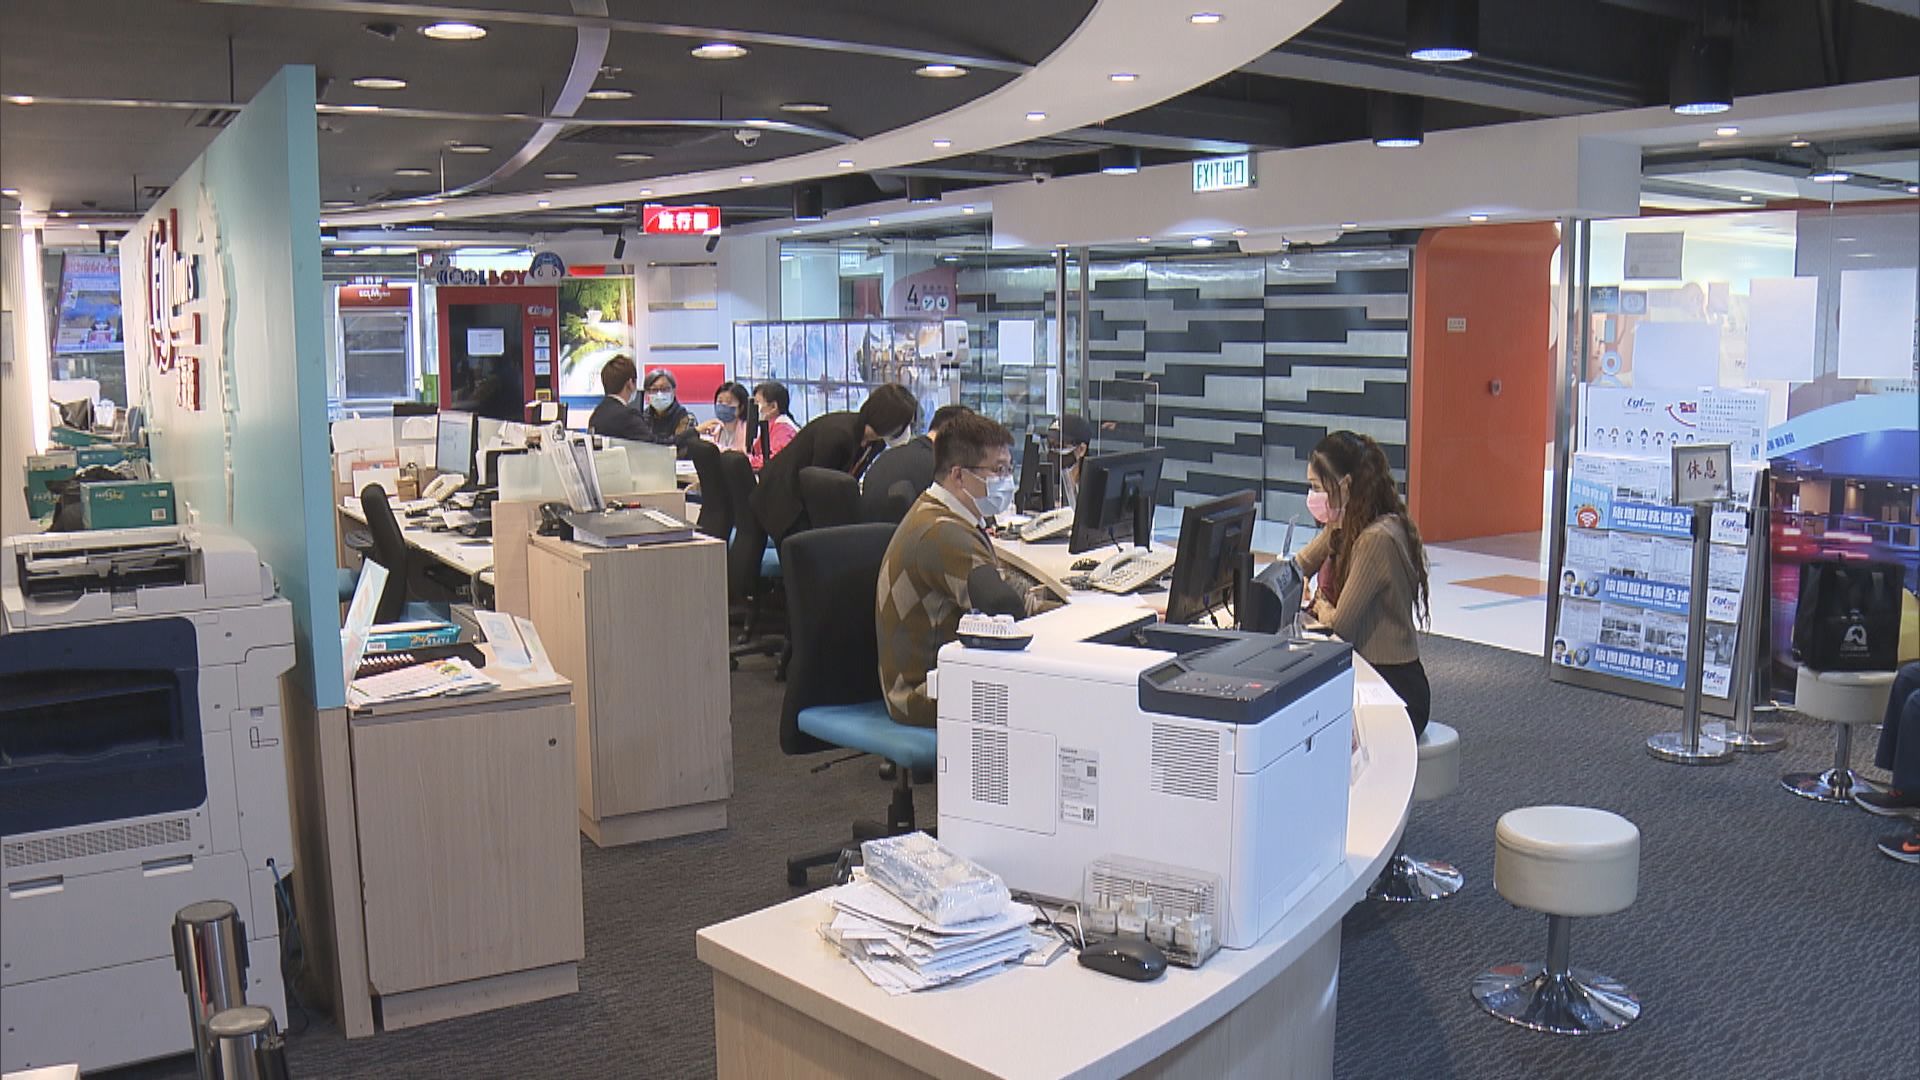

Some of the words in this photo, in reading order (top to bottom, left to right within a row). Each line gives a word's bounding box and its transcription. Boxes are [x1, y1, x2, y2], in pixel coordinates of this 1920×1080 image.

[1197, 163, 1220, 188] EXIT
[1223, 160, 1244, 185] 出口
[1687, 456, 1717, 480] 休息
